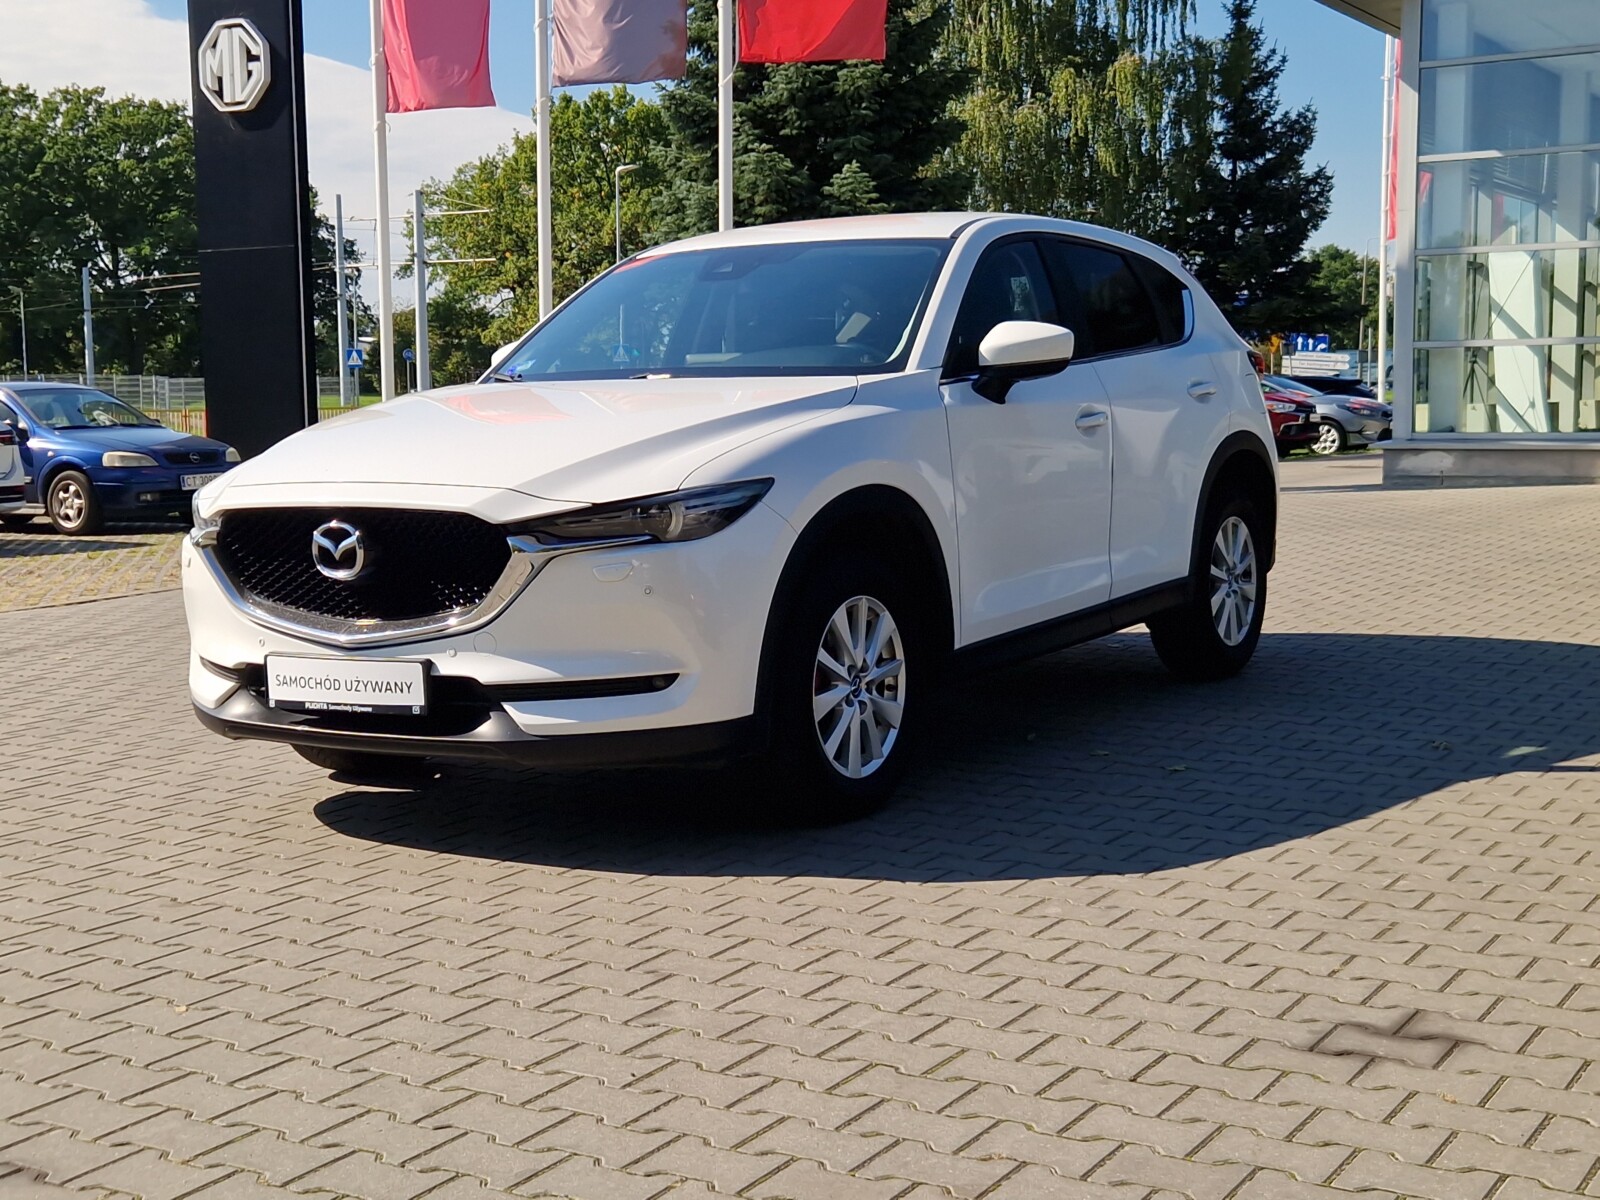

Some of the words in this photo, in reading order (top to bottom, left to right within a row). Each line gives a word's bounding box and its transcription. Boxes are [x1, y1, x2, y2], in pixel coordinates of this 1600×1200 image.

[205, 26, 261, 103] MG
[186, 476, 197, 487] CT
[275, 674, 341, 691] SAMOCHÓD
[344, 676, 413, 694] UŻYWANY
